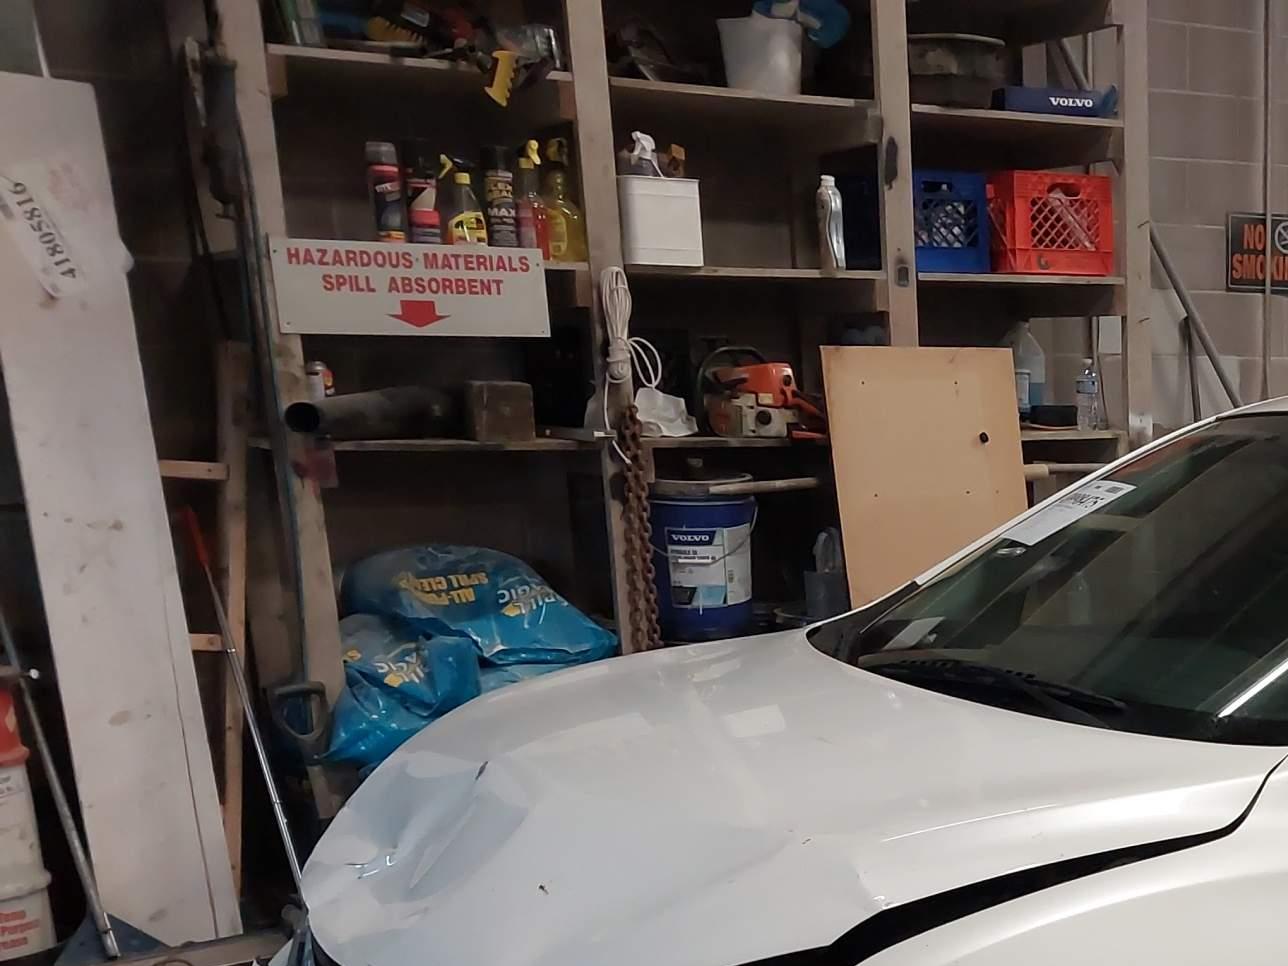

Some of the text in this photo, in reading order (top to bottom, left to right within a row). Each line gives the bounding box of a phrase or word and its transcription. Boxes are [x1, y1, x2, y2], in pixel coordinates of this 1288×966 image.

[1048, 97, 1094, 107] VOLVO
[488, 207, 516, 217] MAX
[8, 182, 76, 278] 41805816
[1243, 223, 1265, 251] NO
[286, 247, 530, 273] HAZARDOUS MATERIALS
[322, 273, 503, 296] SPILL ABSORBENT
